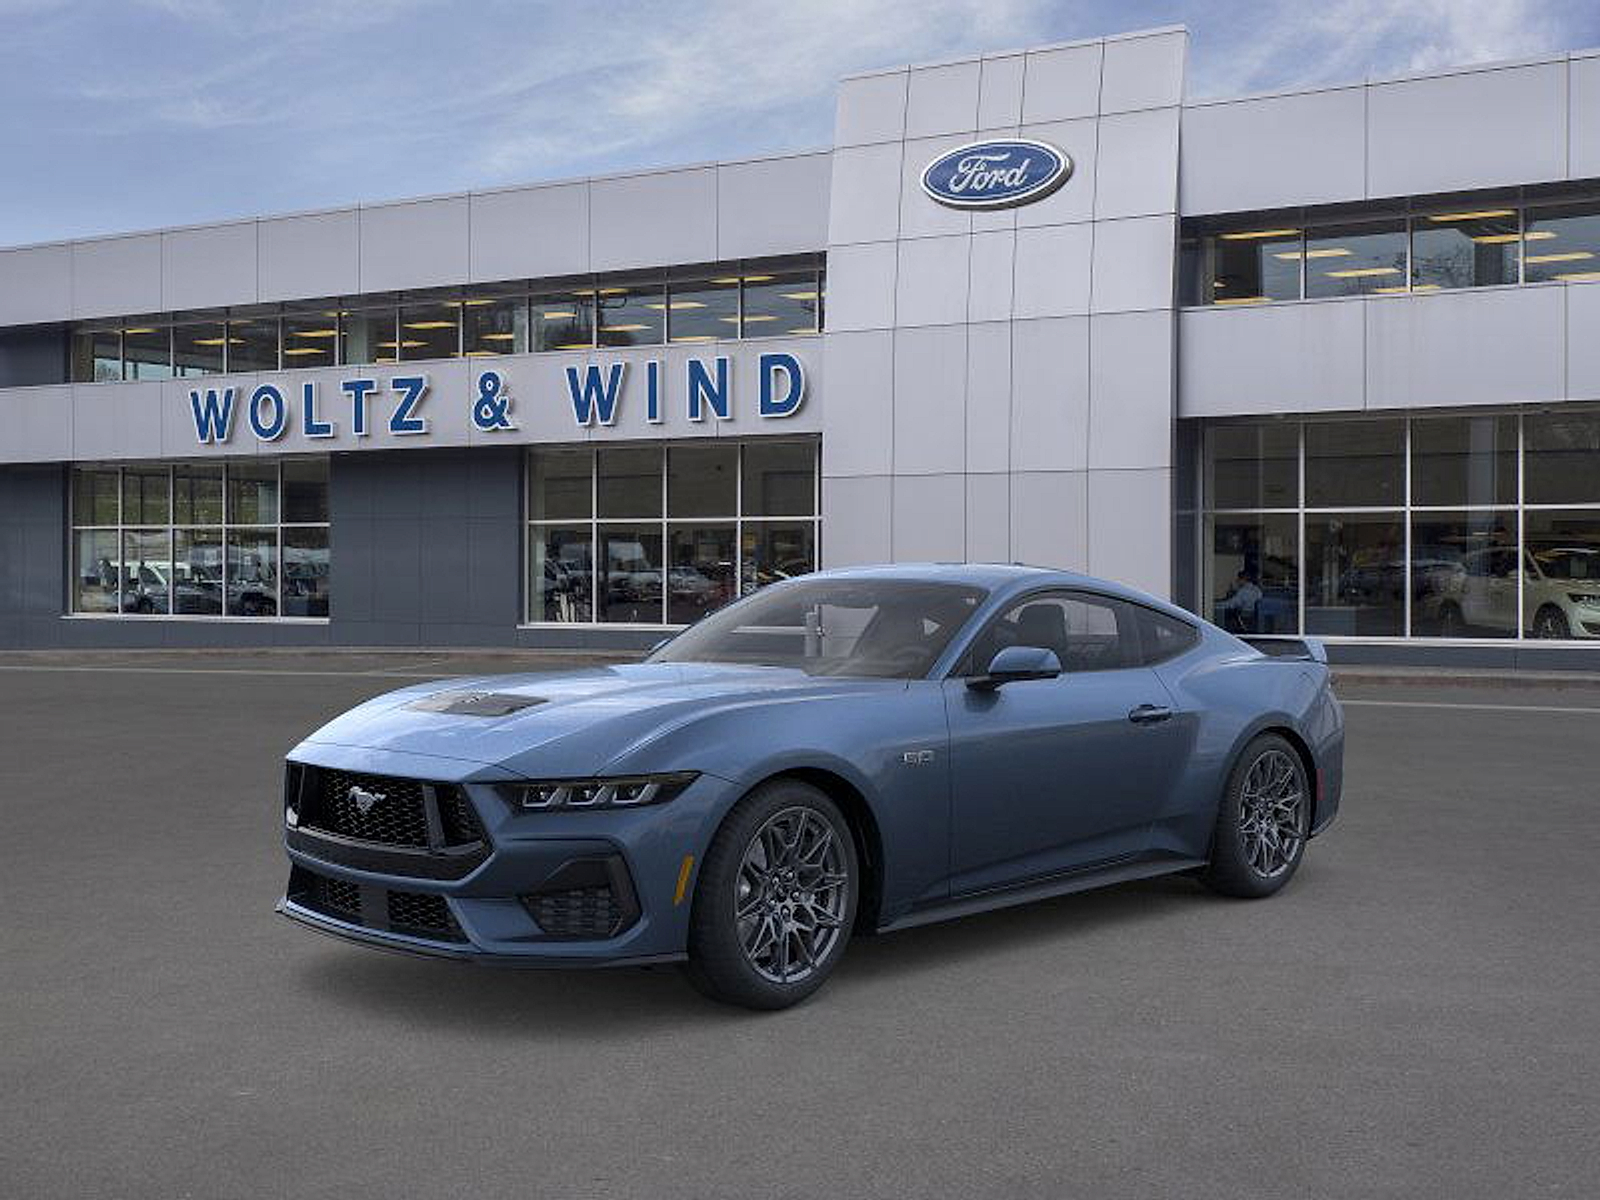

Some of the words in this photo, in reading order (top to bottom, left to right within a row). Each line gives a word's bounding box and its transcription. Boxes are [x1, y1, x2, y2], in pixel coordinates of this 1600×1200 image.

[950, 152, 1031, 193] Ford
[190, 377, 427, 443] WOLTZ
[472, 371, 518, 431] &
[566, 353, 806, 426] WIND
